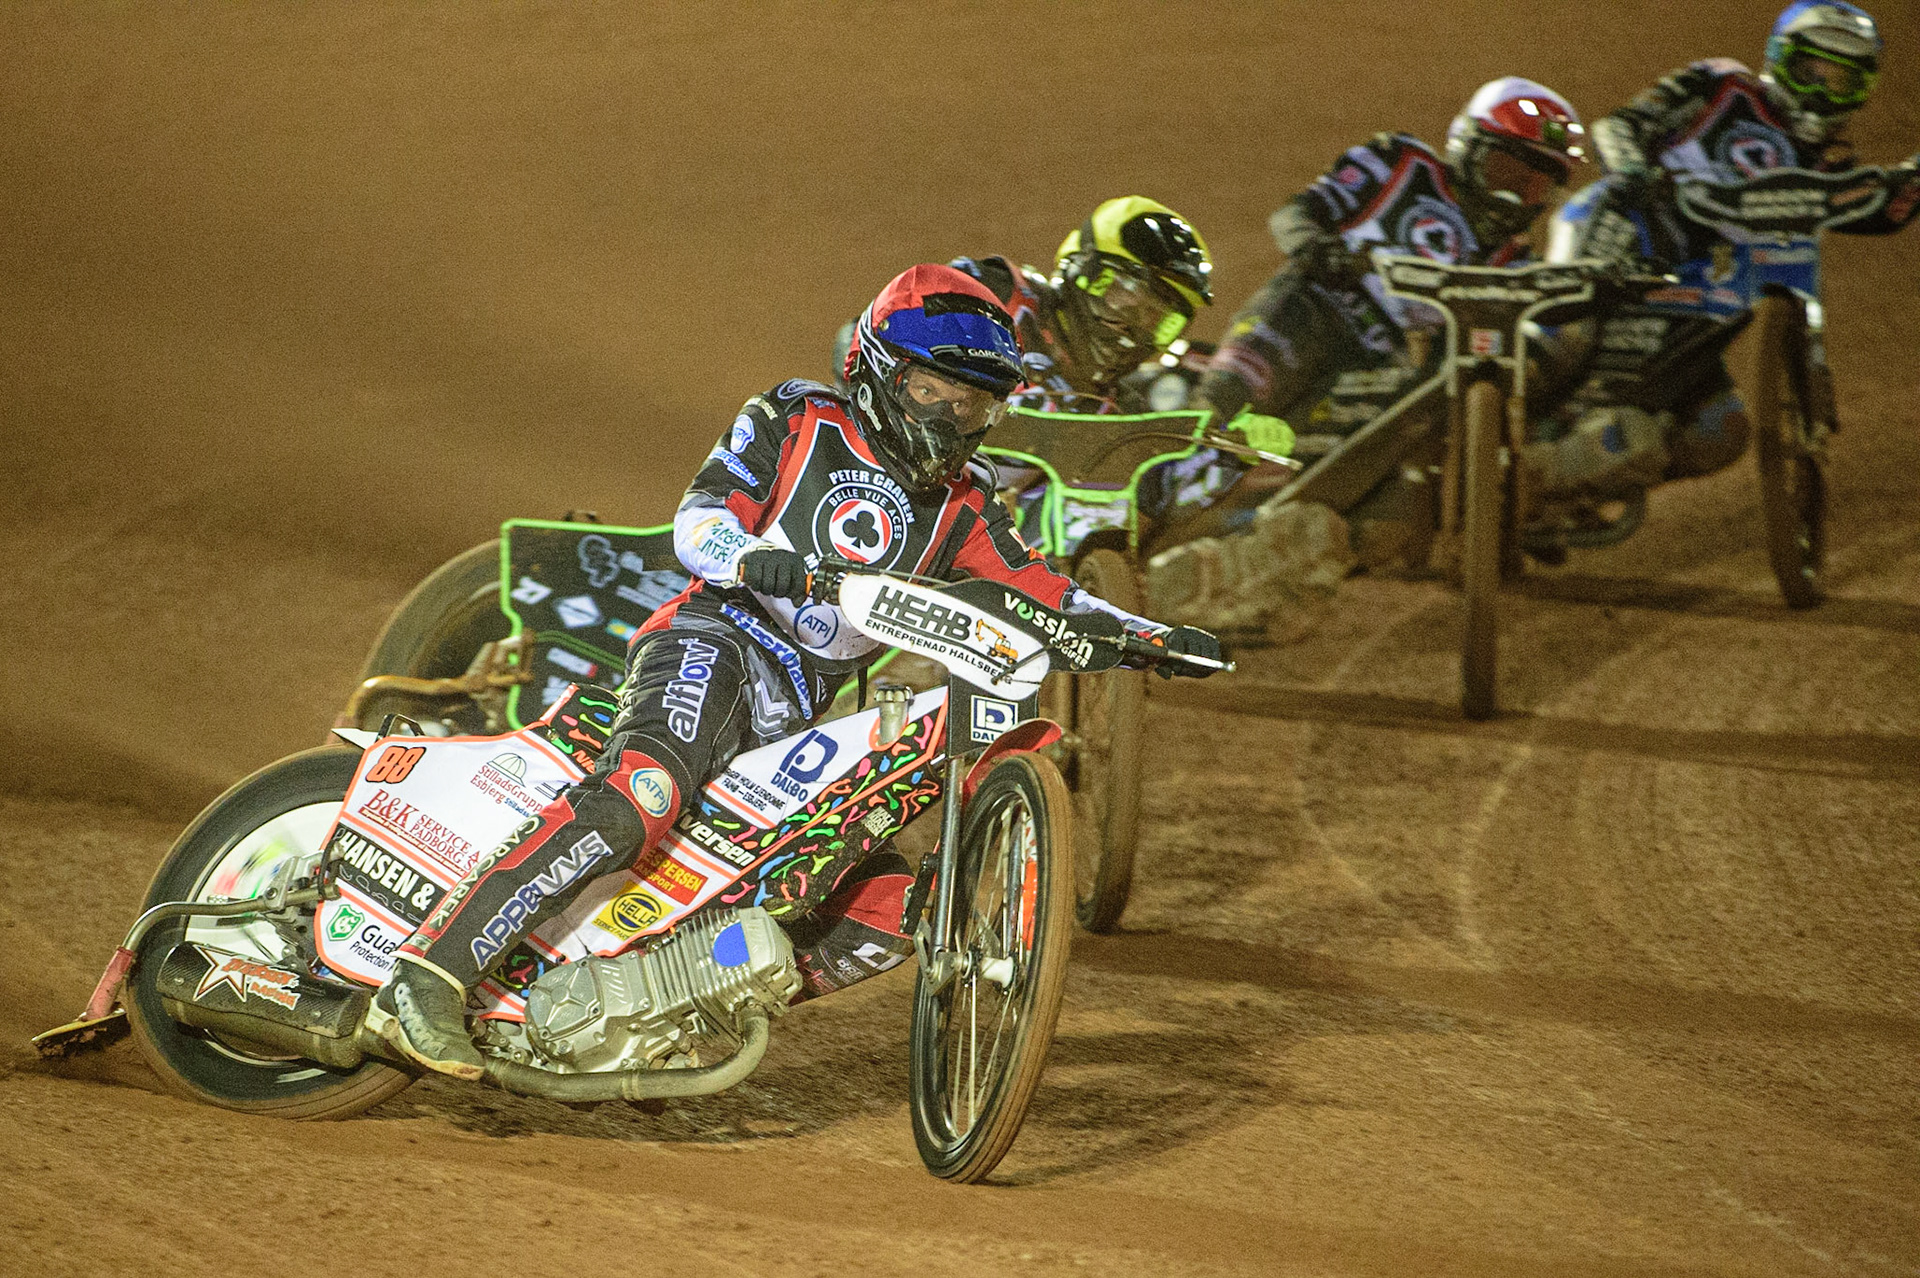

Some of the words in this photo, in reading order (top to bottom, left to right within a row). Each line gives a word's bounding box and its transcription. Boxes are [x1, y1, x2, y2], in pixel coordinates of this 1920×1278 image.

[828, 469, 870, 485] PETER
[872, 473, 916, 524] CRAVEN
[828, 488, 859, 507] BELLE
[864, 490, 889, 507] VUE
[887, 508, 903, 540] ACES
[801, 613, 832, 639] ATPI
[871, 585, 972, 641] HEAB
[865, 619, 947, 653] ENTREPRENAD
[365, 745, 427, 784] 88
[470, 774, 505, 805] Esbjerg
[478, 764, 543, 813] StilladsGrupp
[639, 777, 666, 808] ATPI
[770, 771, 809, 802] DALBO
[364, 788, 419, 829] B&K
[410, 823, 465, 864] PADBORG
[417, 814, 472, 854] SERVICE
[679, 808, 757, 867] versen
[339, 831, 420, 899] HANSEN
[410, 882, 436, 911] &
[635, 863, 677, 892] ANSPORT
[643, 849, 704, 892] ESPERSEN
[618, 899, 659, 927] HELLA
[350, 940, 389, 971] Protection
[361, 924, 397, 956] Gua
